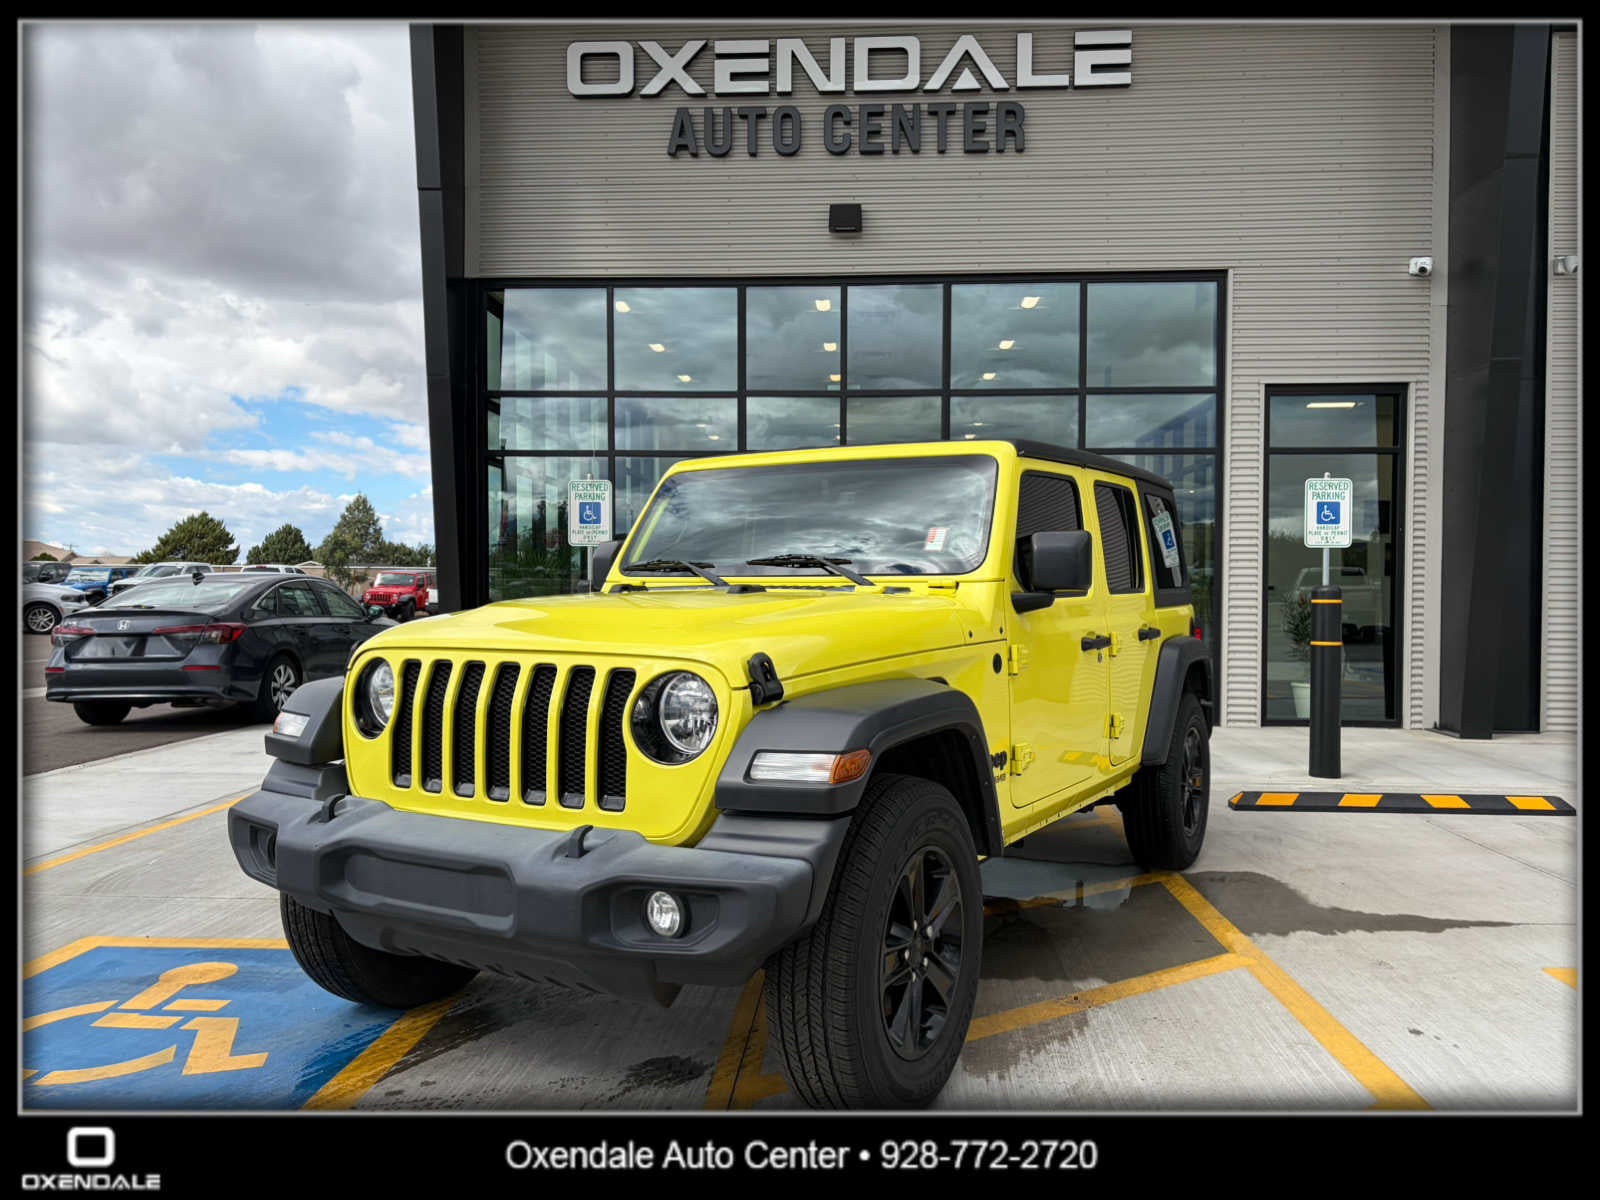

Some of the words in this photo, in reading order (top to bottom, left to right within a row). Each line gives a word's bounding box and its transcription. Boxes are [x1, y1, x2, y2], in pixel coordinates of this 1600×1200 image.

[566, 30, 1132, 98] OXENDALE
[667, 104, 802, 157] AUTO
[823, 100, 1026, 156] CENTER
[571, 483, 609, 492] RESERVED
[1308, 481, 1349, 491] RESERVED
[574, 492, 606, 501] PARKING
[1311, 491, 1346, 501] PARKING
